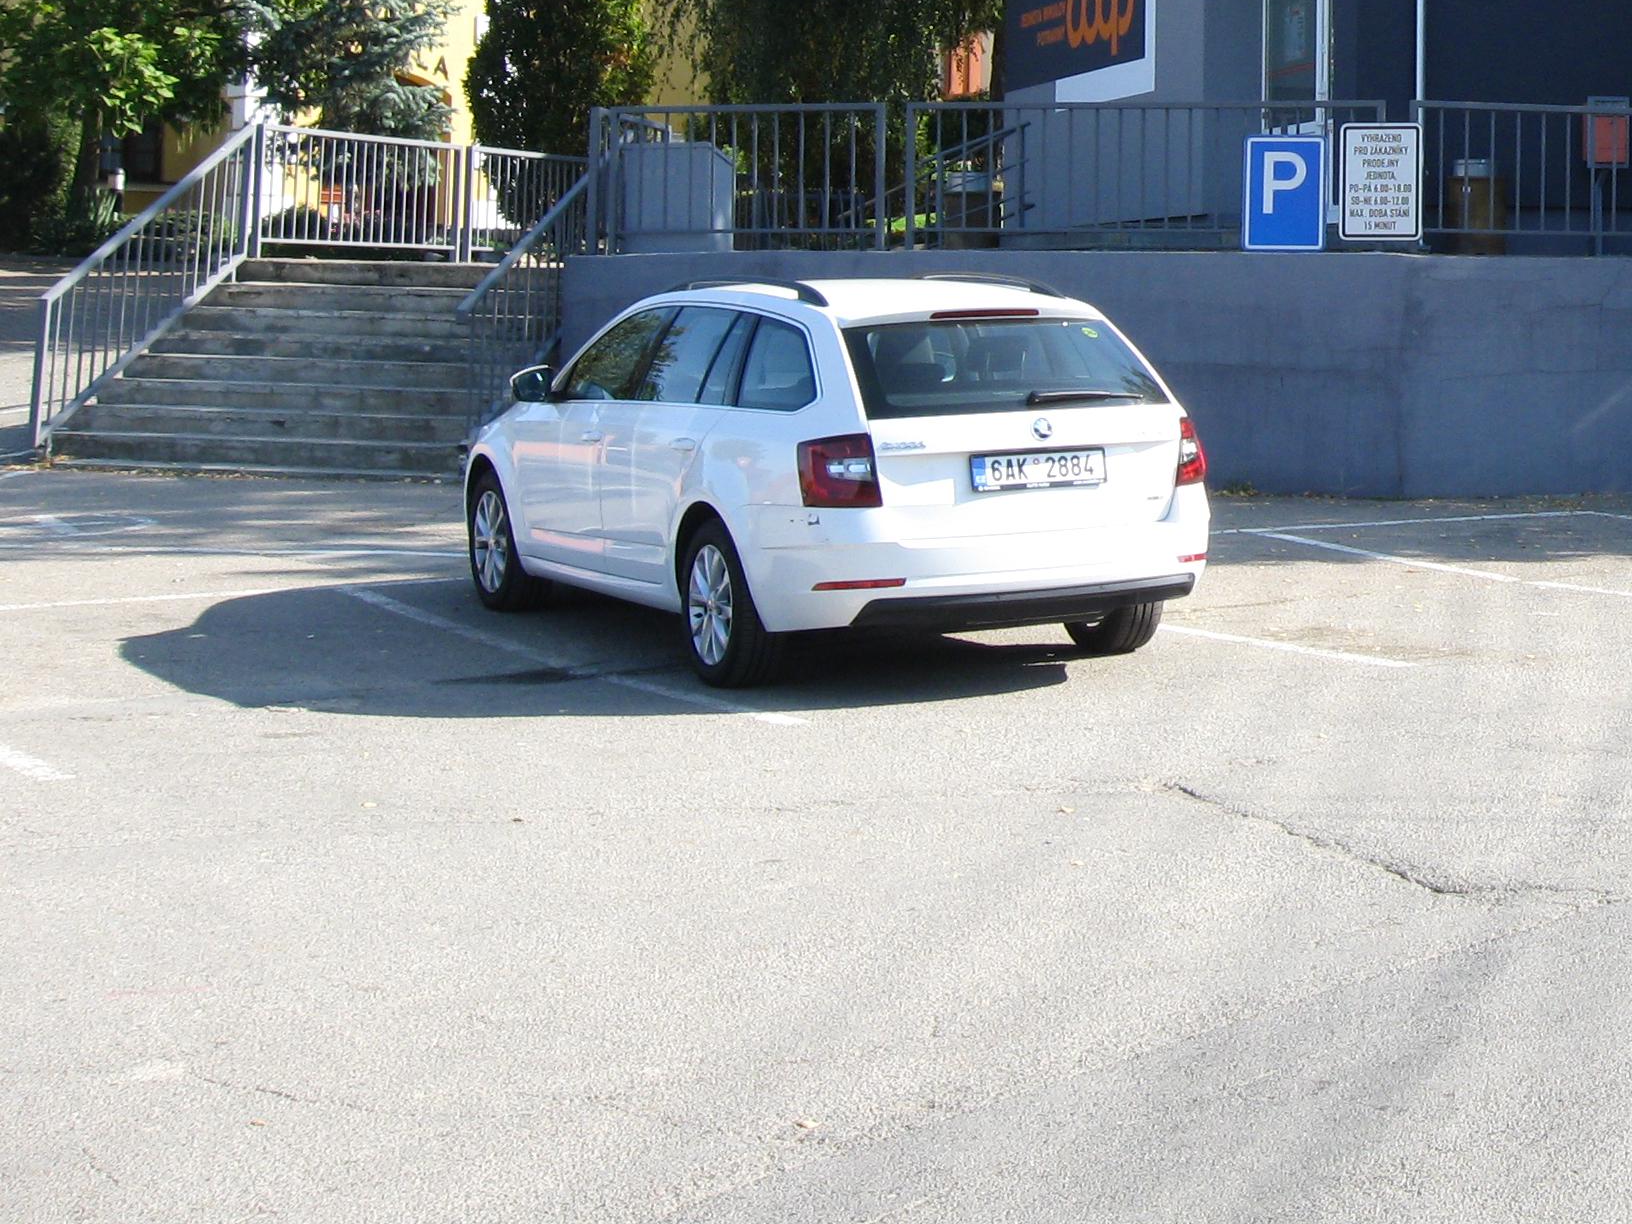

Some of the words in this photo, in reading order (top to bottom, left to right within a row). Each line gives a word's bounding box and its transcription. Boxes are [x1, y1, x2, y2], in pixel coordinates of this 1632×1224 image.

[1353, 146, 1369, 156] PRO
[1362, 159, 1400, 168] PRODEJNY
[1262, 151, 1308, 215] P
[1368, 208, 1389, 218] DOBA
[1364, 221, 1373, 231] 15
[1373, 221, 1397, 231] MINUT
[991, 458, 1028, 482] 6AK
[1045, 454, 1095, 479] 2884
